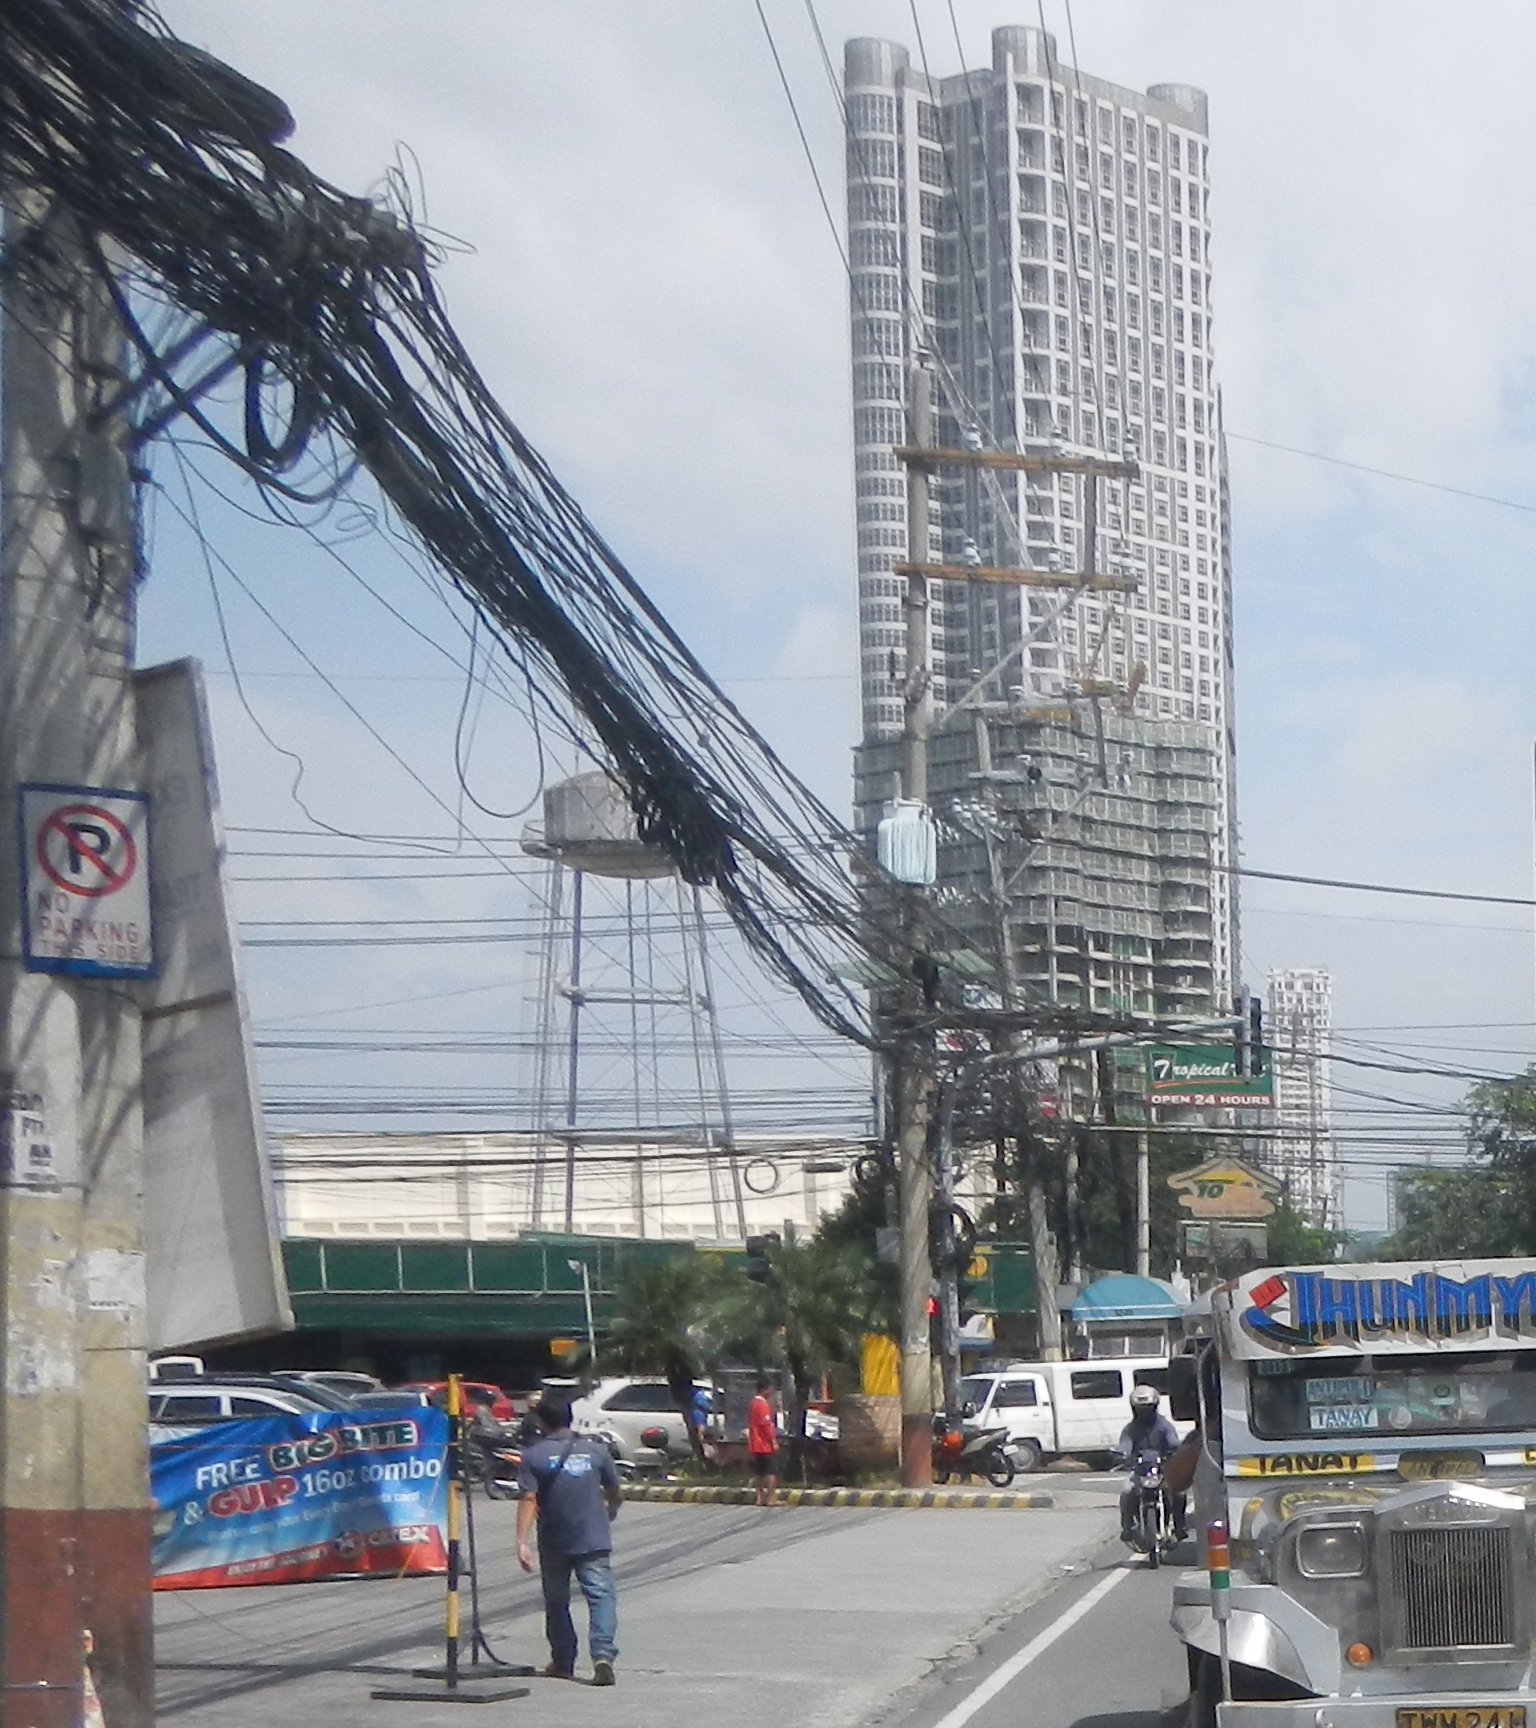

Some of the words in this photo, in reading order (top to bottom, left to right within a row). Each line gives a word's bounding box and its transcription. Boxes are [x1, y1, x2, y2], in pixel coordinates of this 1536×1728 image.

[37, 891, 70, 914] NO
[38, 916, 139, 944] PARKING
[98, 944, 139, 960] SIDE
[1154, 1058, 1229, 1079] Tropical
[1151, 1096, 1191, 1106] OPEN
[1195, 1094, 1216, 1107] 24
[1220, 1096, 1271, 1106] HOURS
[1313, 1406, 1373, 1426] TANAY
[195, 1453, 263, 1491] FREE
[270, 1430, 338, 1473] BIG
[336, 1418, 418, 1453] BITE
[183, 1500, 204, 1526] &
[207, 1473, 300, 1519] GULP
[360, 1455, 442, 1484] combo
